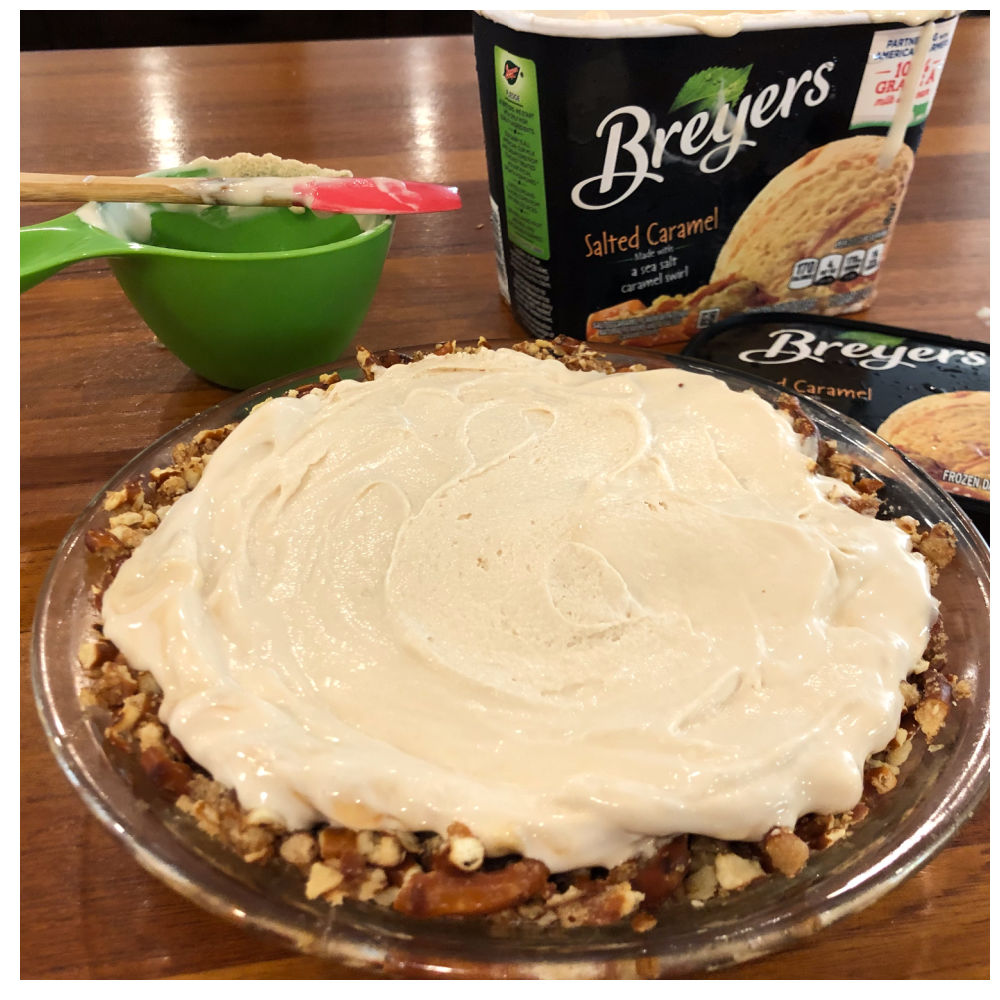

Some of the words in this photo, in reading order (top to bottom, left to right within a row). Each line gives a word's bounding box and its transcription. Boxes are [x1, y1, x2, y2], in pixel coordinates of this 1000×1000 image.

[571, 61, 835, 211] Breyers
[585, 224, 640, 258] Salted
[646, 206, 718, 246] Caramel
[631, 268, 638, 277] a
[640, 262, 657, 275] sea
[659, 255, 678, 270] salt
[634, 250, 655, 261] Made
[657, 246, 674, 256] with
[620, 273, 663, 294] caramel
[665, 265, 689, 283] swirl
[738, 328, 987, 370] Breyers
[793, 379, 873, 401] Caramel
[942, 469, 980, 488] FROZEN
